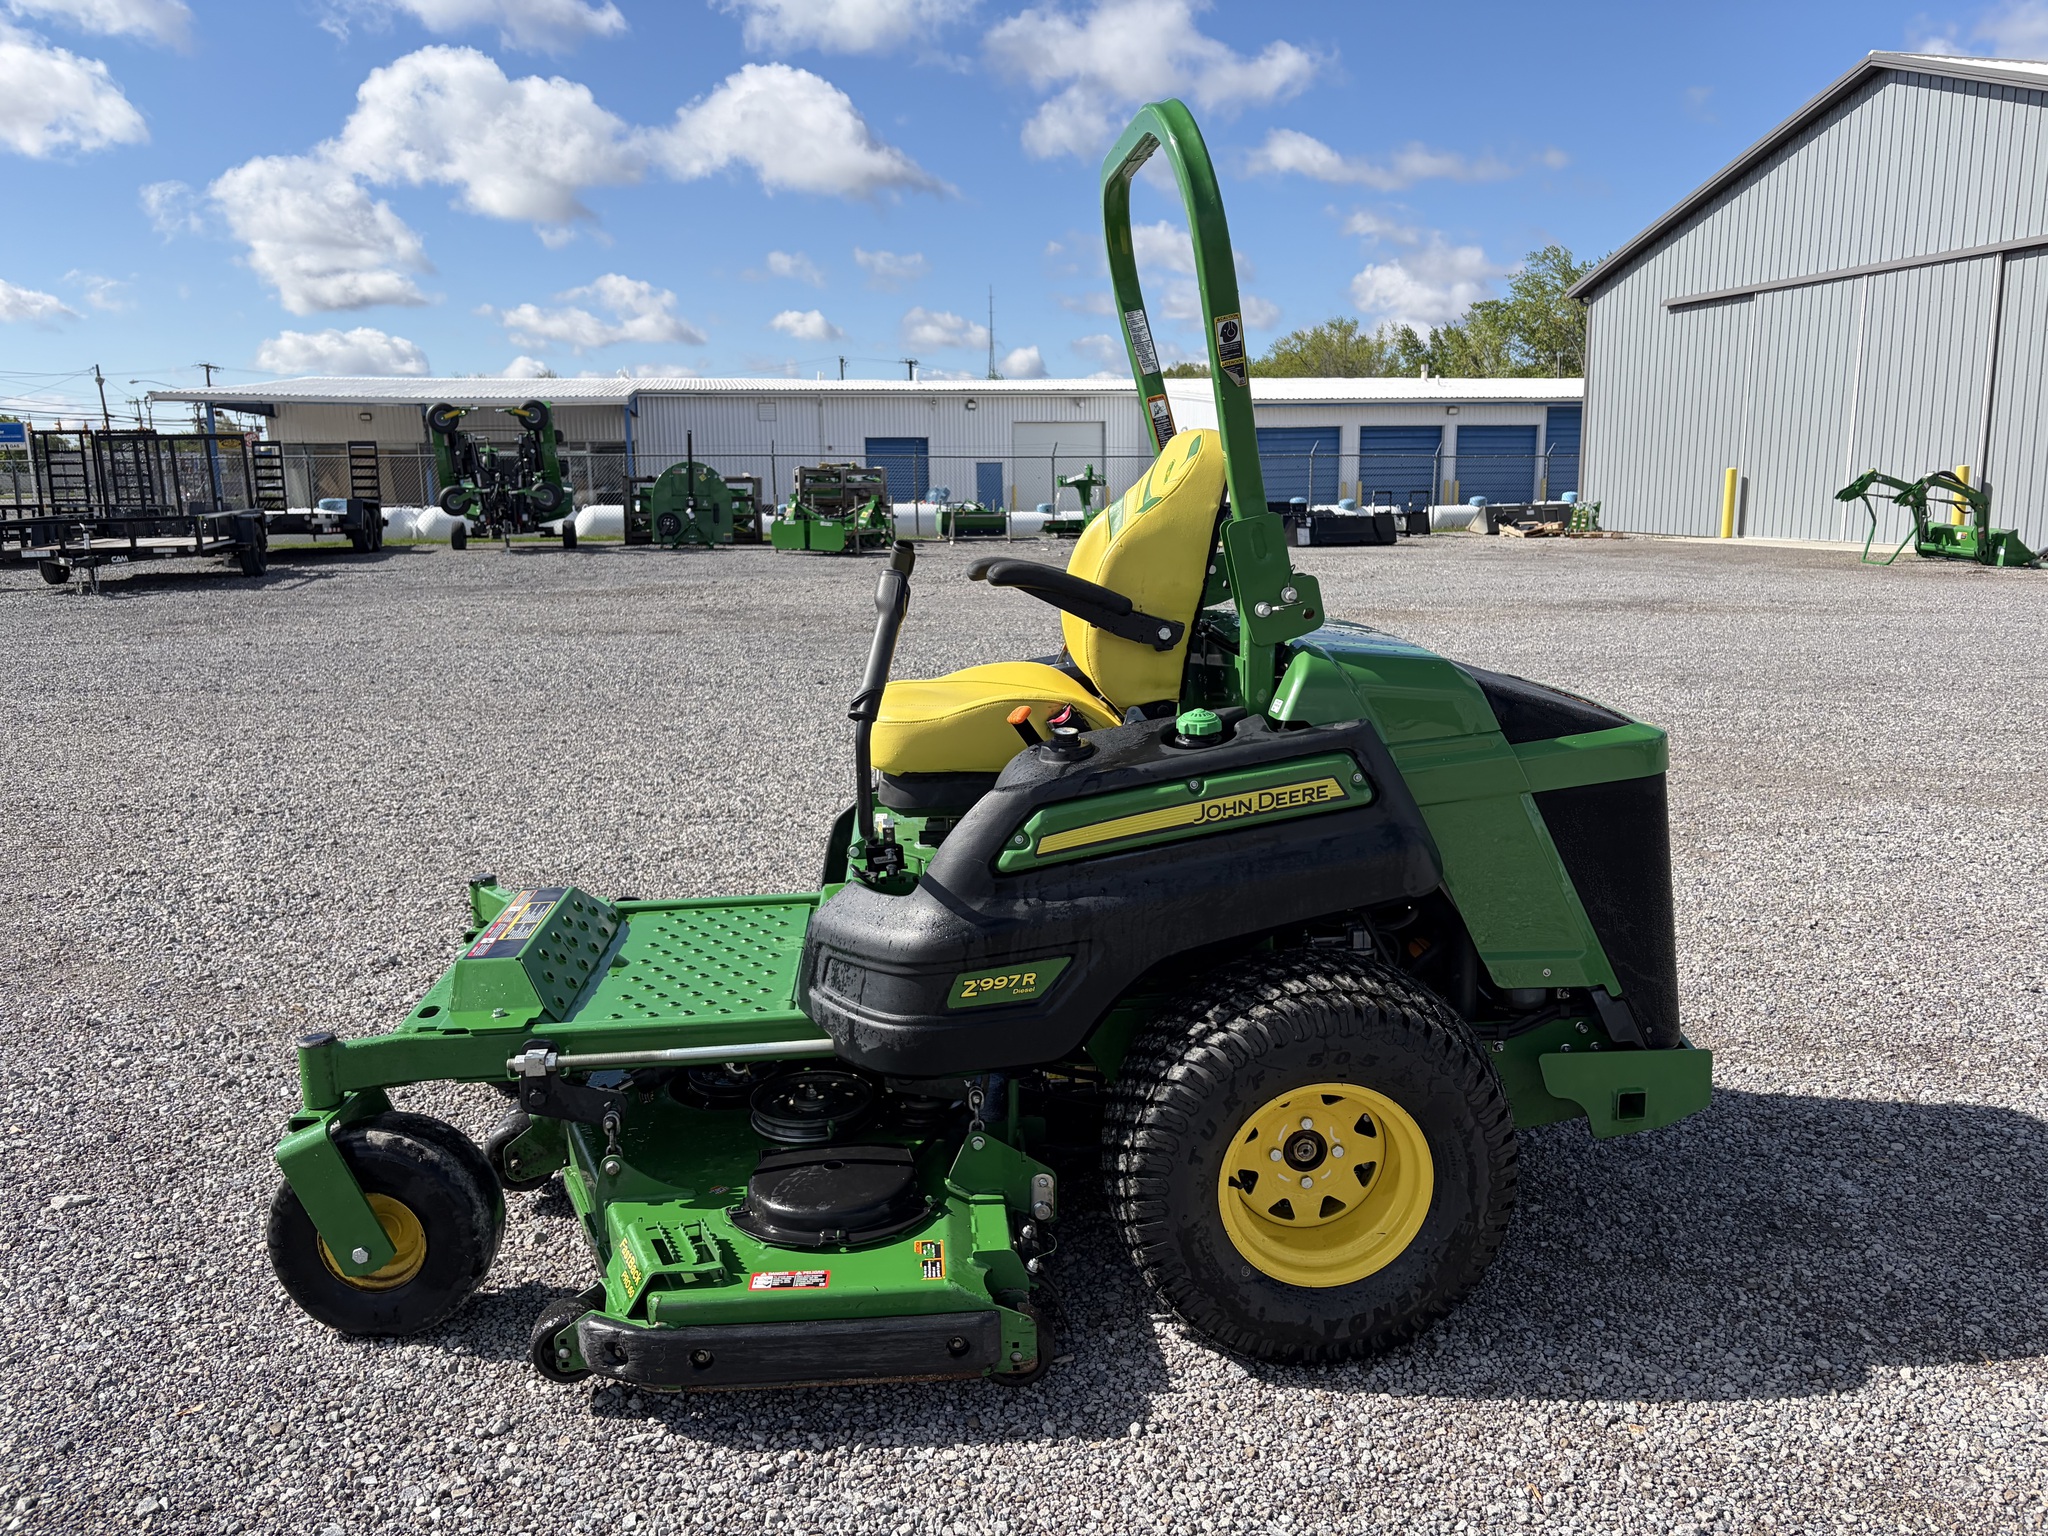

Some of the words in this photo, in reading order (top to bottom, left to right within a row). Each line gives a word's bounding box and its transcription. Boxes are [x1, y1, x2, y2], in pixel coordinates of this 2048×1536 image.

[111, 555, 129, 563] CAM
[1193, 797, 1253, 823] JOHN
[1258, 784, 1329, 810] DEERE
[1012, 986, 1036, 995] Diesel
[619, 1237, 642, 1287] FastBack
